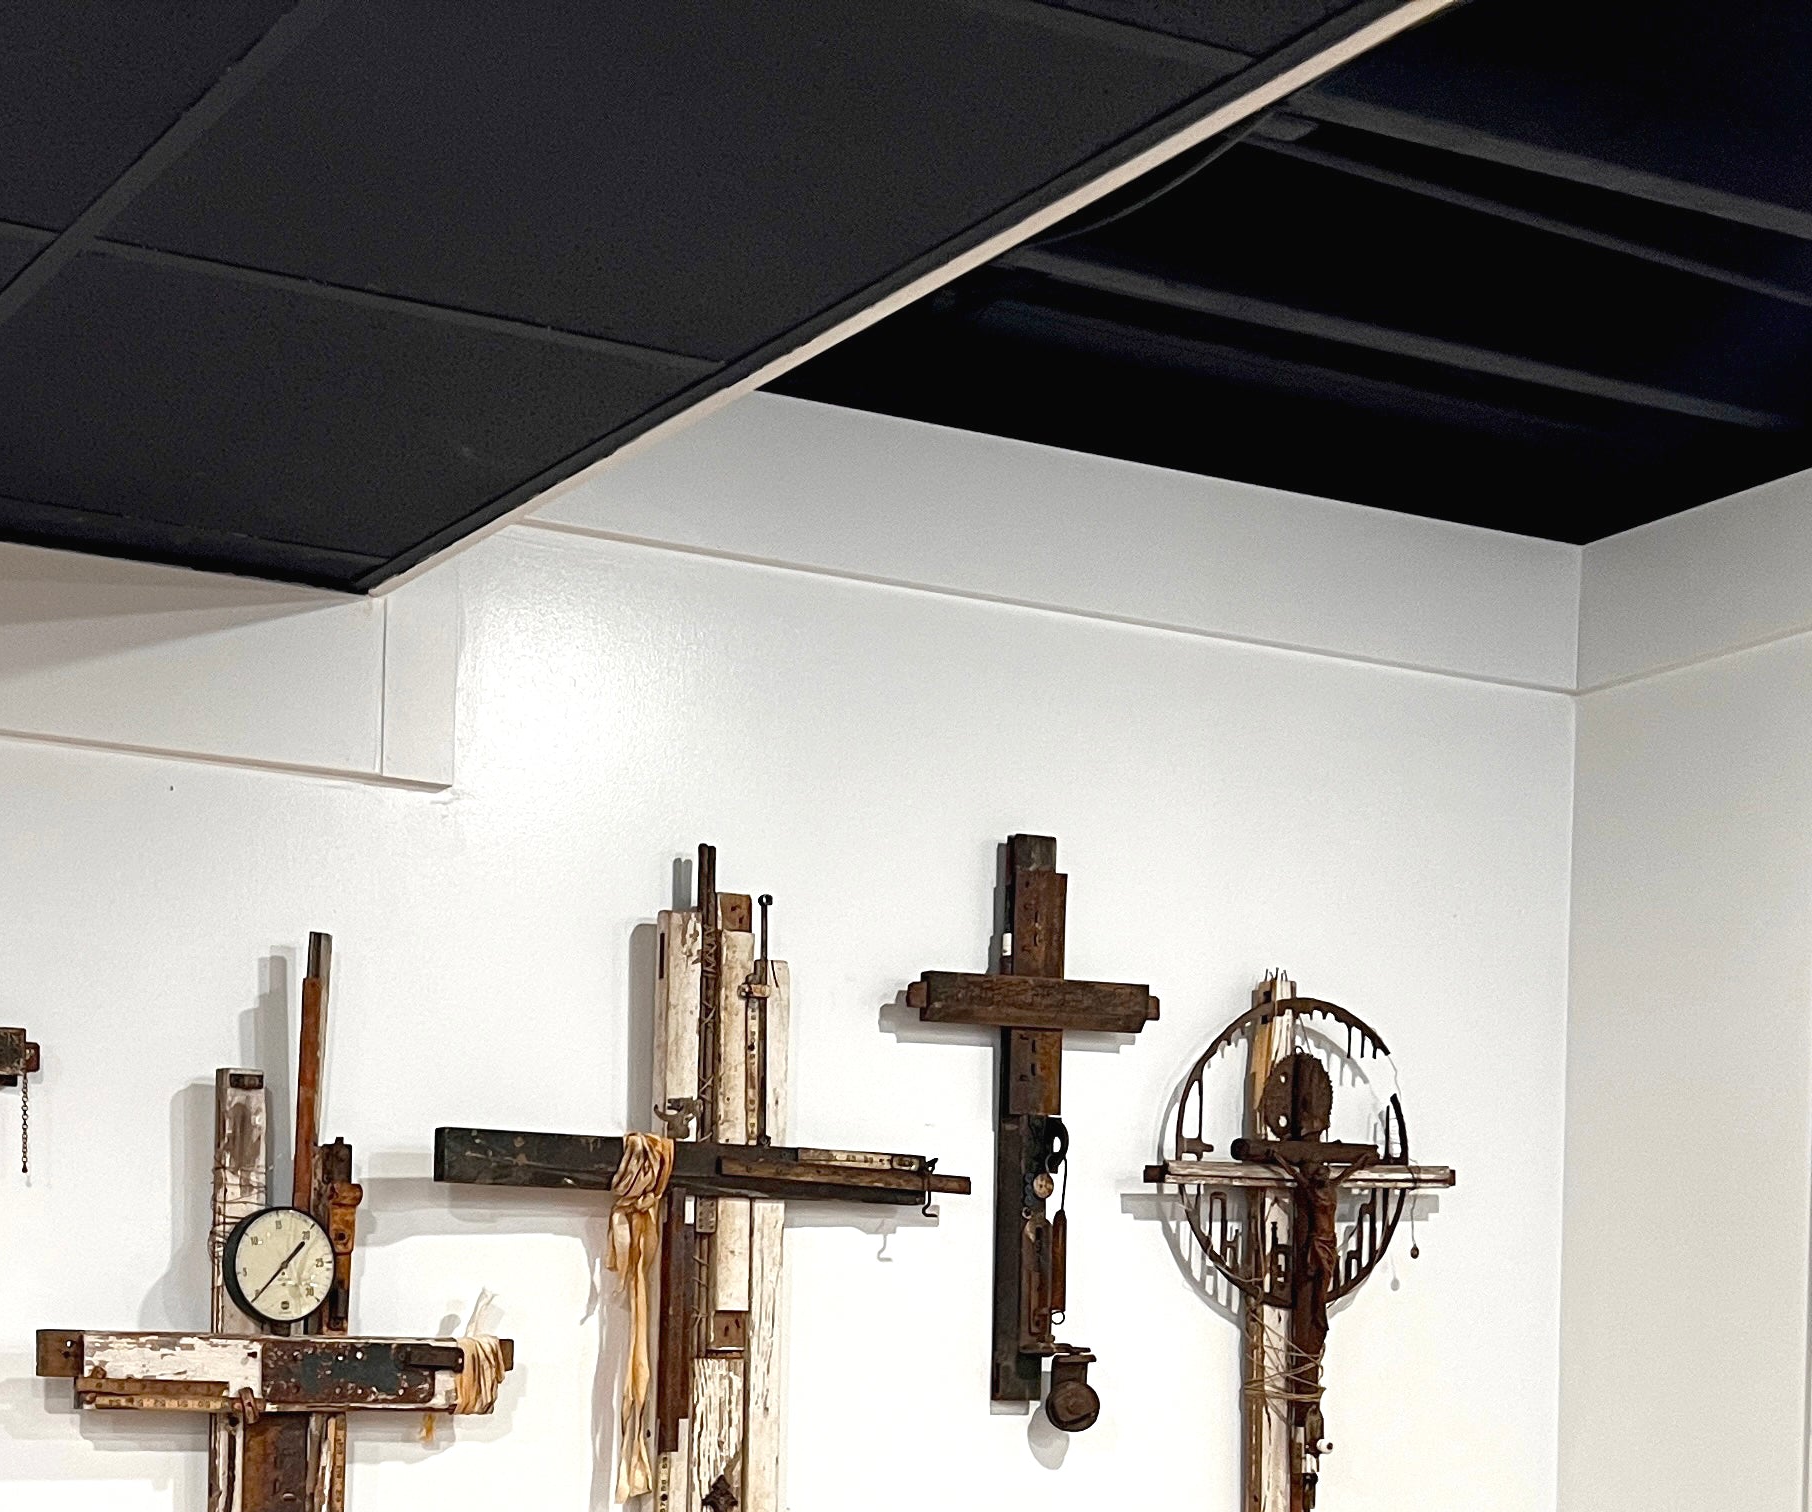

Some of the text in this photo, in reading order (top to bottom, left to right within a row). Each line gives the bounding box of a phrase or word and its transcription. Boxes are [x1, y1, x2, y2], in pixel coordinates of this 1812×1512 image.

[275, 1220, 283, 1230] 15
[301, 1230, 311, 1241] 20
[250, 1236, 259, 1246] 10
[315, 1257, 325, 1268] 25
[242, 1267, 248, 1277] 5
[305, 1287, 315, 1297] 30
